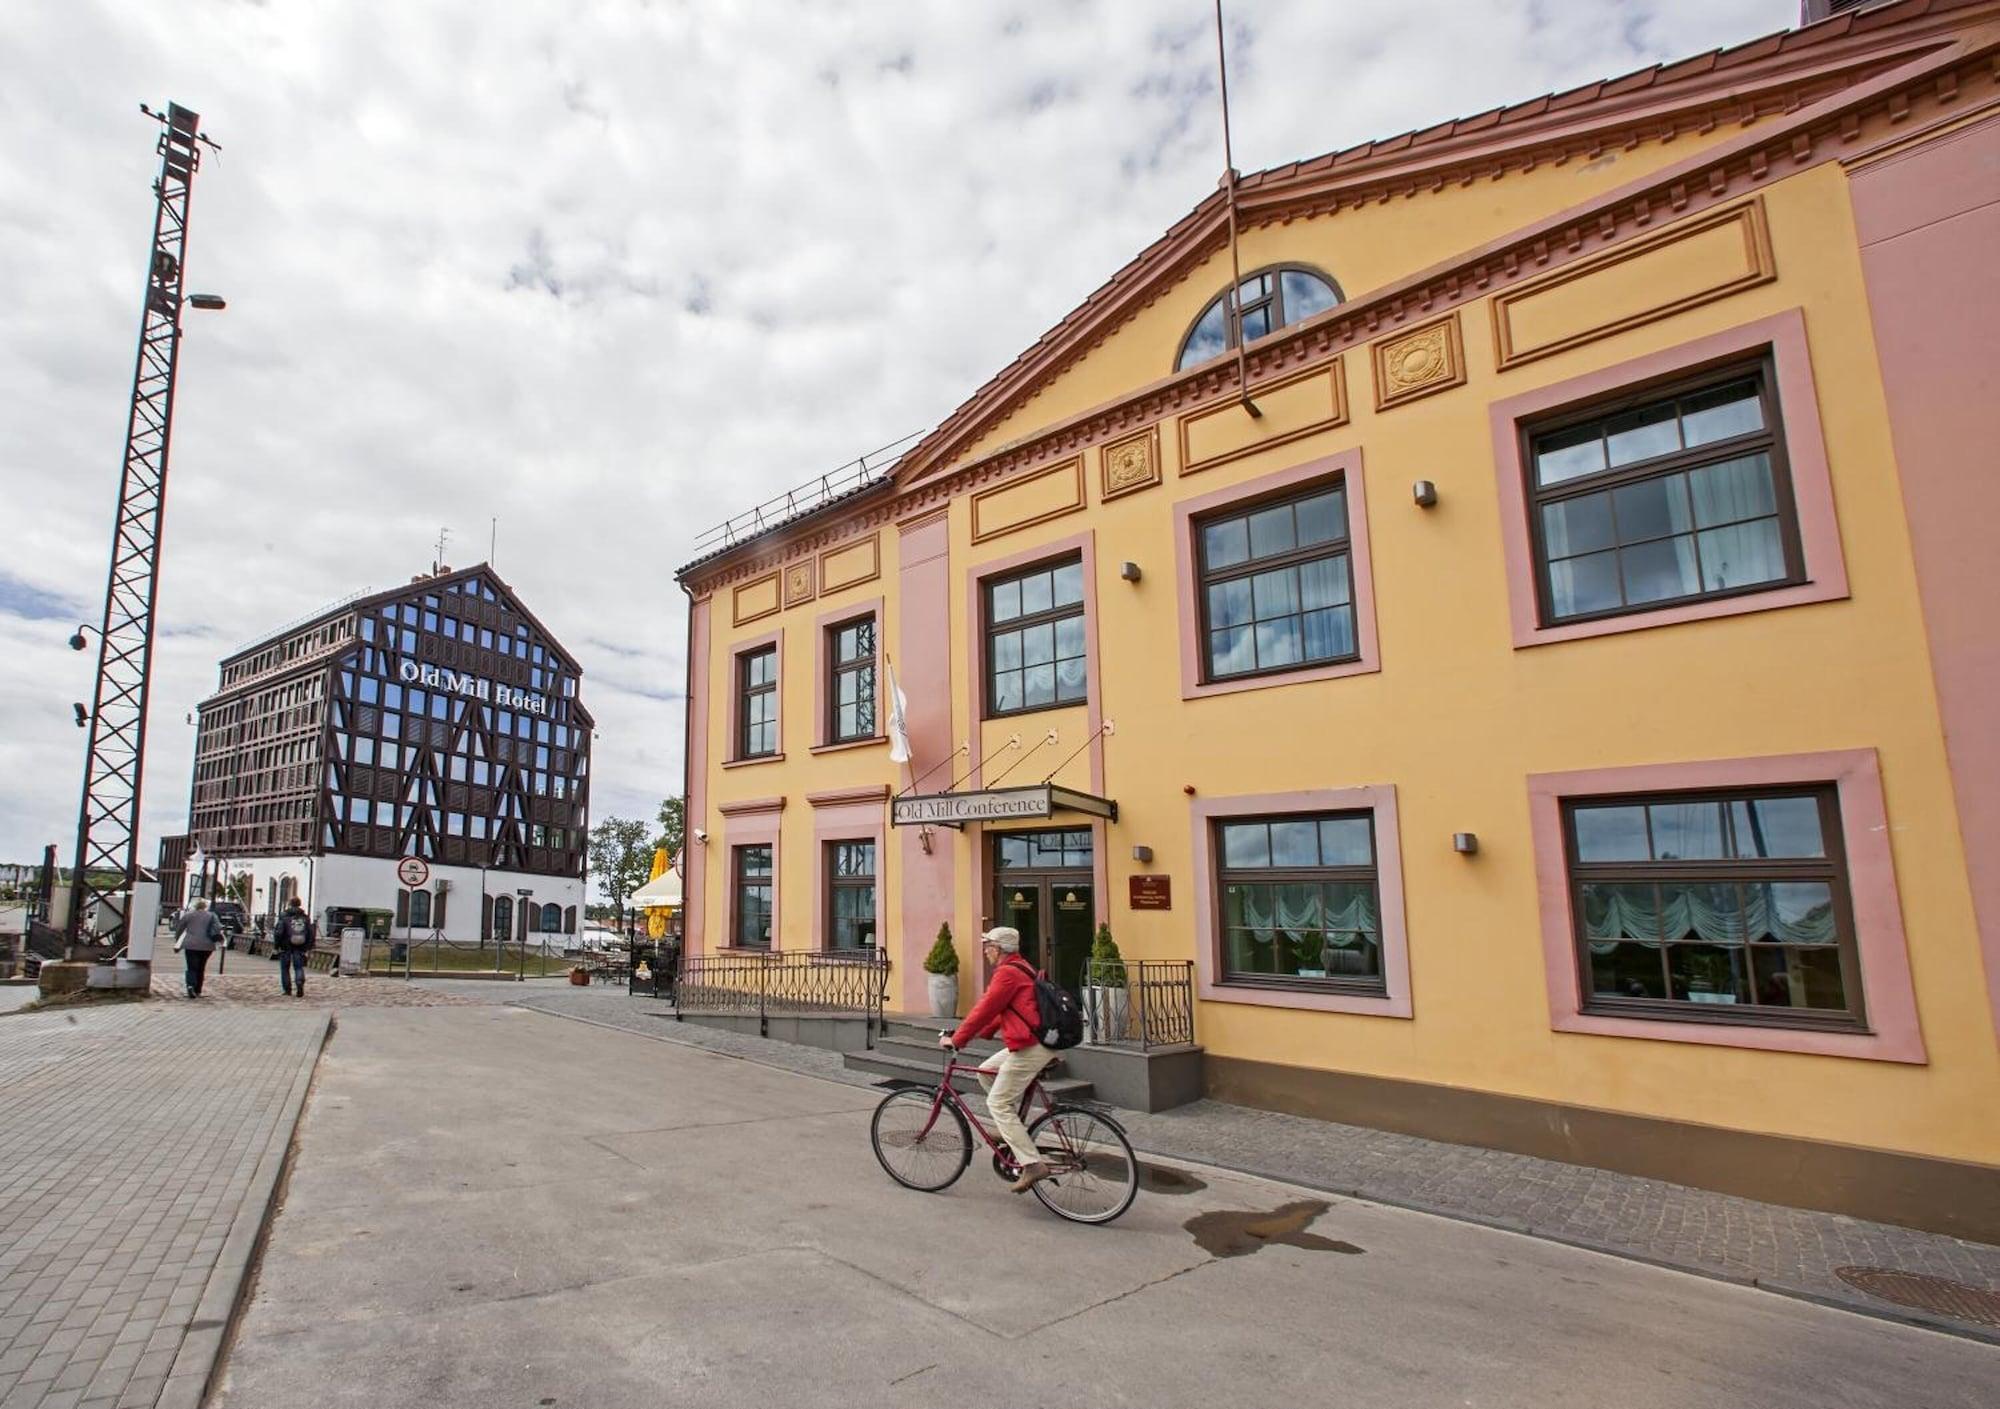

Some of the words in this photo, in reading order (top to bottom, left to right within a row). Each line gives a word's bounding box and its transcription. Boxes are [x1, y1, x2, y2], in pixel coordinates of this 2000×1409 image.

[400, 662, 439, 687] Old
[446, 673, 489, 701] Mill
[495, 683, 546, 715] Hotel
[898, 803, 922, 819] Old
[927, 801, 953, 818] Mill
[955, 798, 1046, 817] Conference
